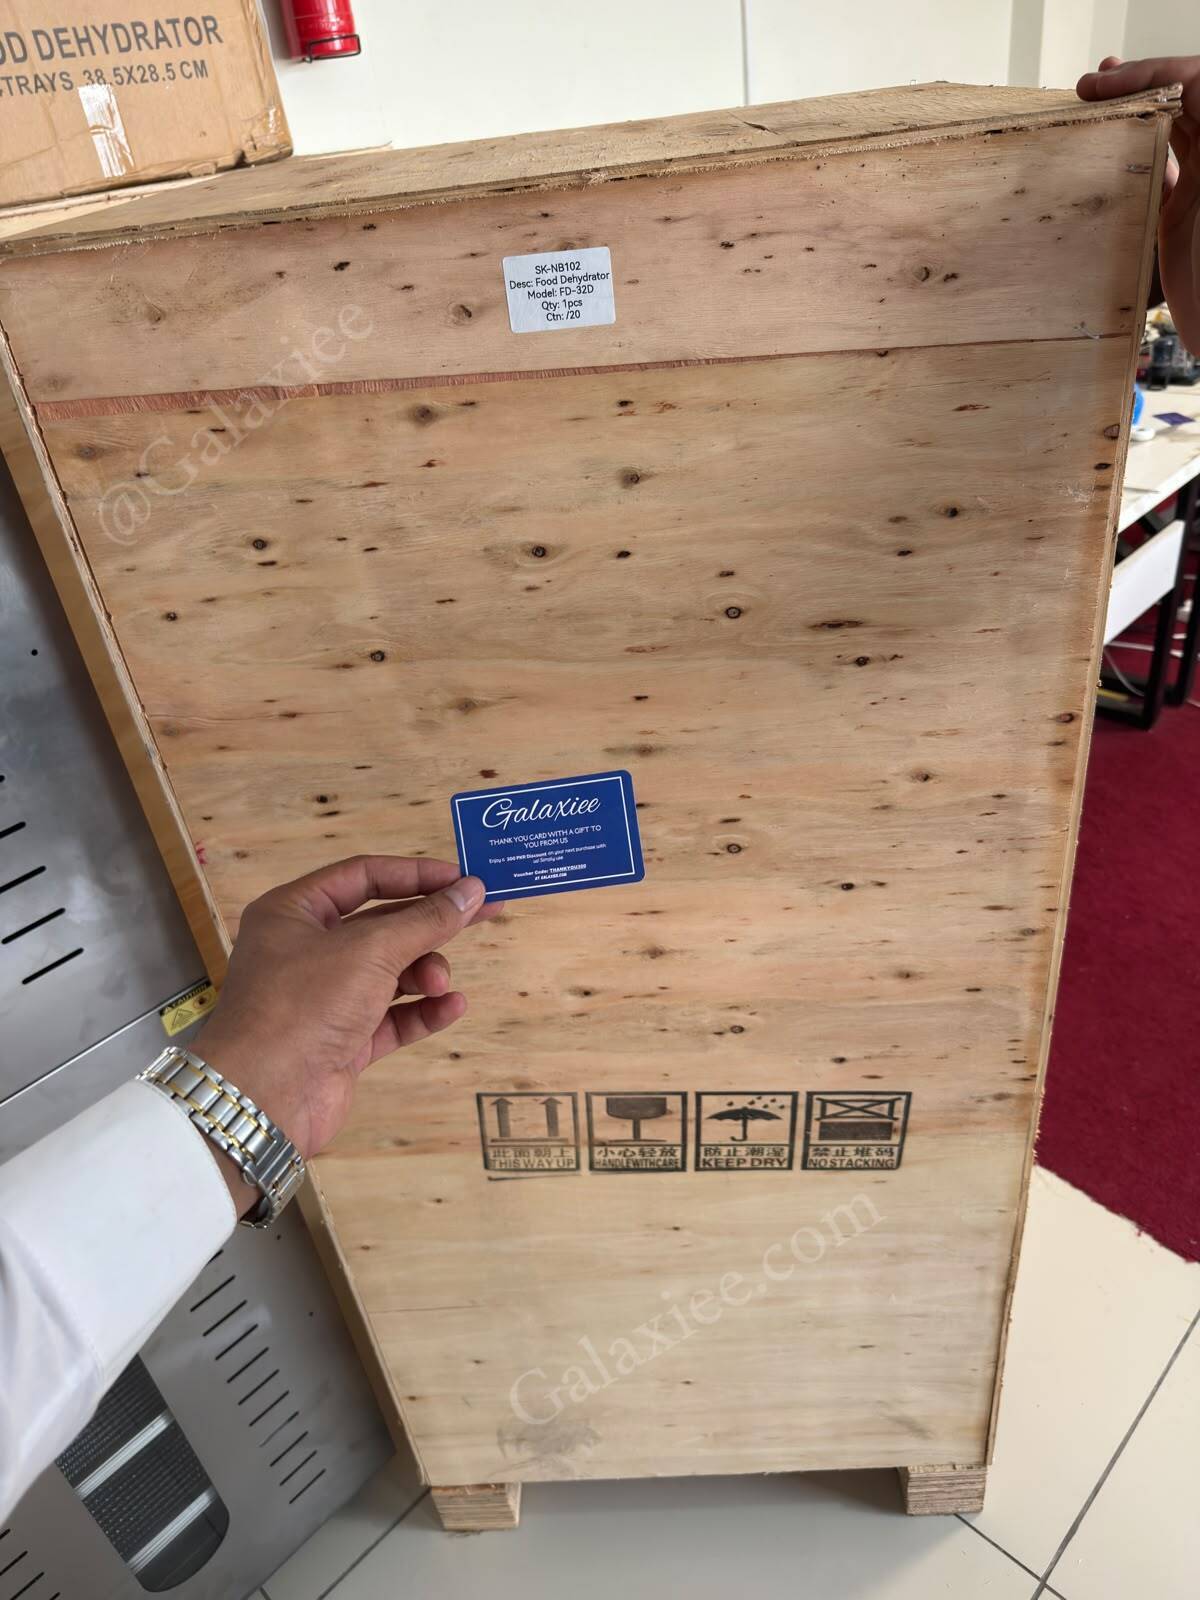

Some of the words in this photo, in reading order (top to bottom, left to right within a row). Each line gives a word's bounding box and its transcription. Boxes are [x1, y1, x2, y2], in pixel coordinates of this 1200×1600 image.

[31, 15, 224, 61] DEHYDRATOR
[82, 62, 177, 87] 38.5X28.5
[180, 59, 209, 80] CM
[535, 261, 582, 275] SK-NB102
[509, 280, 534, 290] Desc:
[535, 276, 558, 287] Food
[560, 272, 611, 285] Dehydrator
[527, 288, 558, 300] Model:
[560, 284, 595, 297] FD-32D
[541, 301, 560, 312] Qty:
[563, 299, 583, 310] 1pcs
[546, 312, 564, 322] Ctn:
[566, 310, 582, 321] /20
[482, 796, 601, 831] Galaxiee
[489, 837, 513, 846] THANK
[513, 834, 529, 843] YOU
[529, 832, 547, 841] CARD
[547, 829, 569, 838] WITH
[574, 826, 590, 835] GIFT
[590, 824, 602, 832] TO
[524, 841, 540, 849] YOU
[540, 838, 559, 847] FROM
[575, 845, 596, 853] purchase
[513, 870, 534, 878] Voucher
[597, 1146, 678, 1158] 小心轻放
[489, 1158, 521, 1169] THIS
[522, 1158, 554, 1169] WAY
[556, 1158, 575, 1169] UP
[702, 1157, 747, 1168] KEEP
[750, 1157, 787, 1168] DRY
